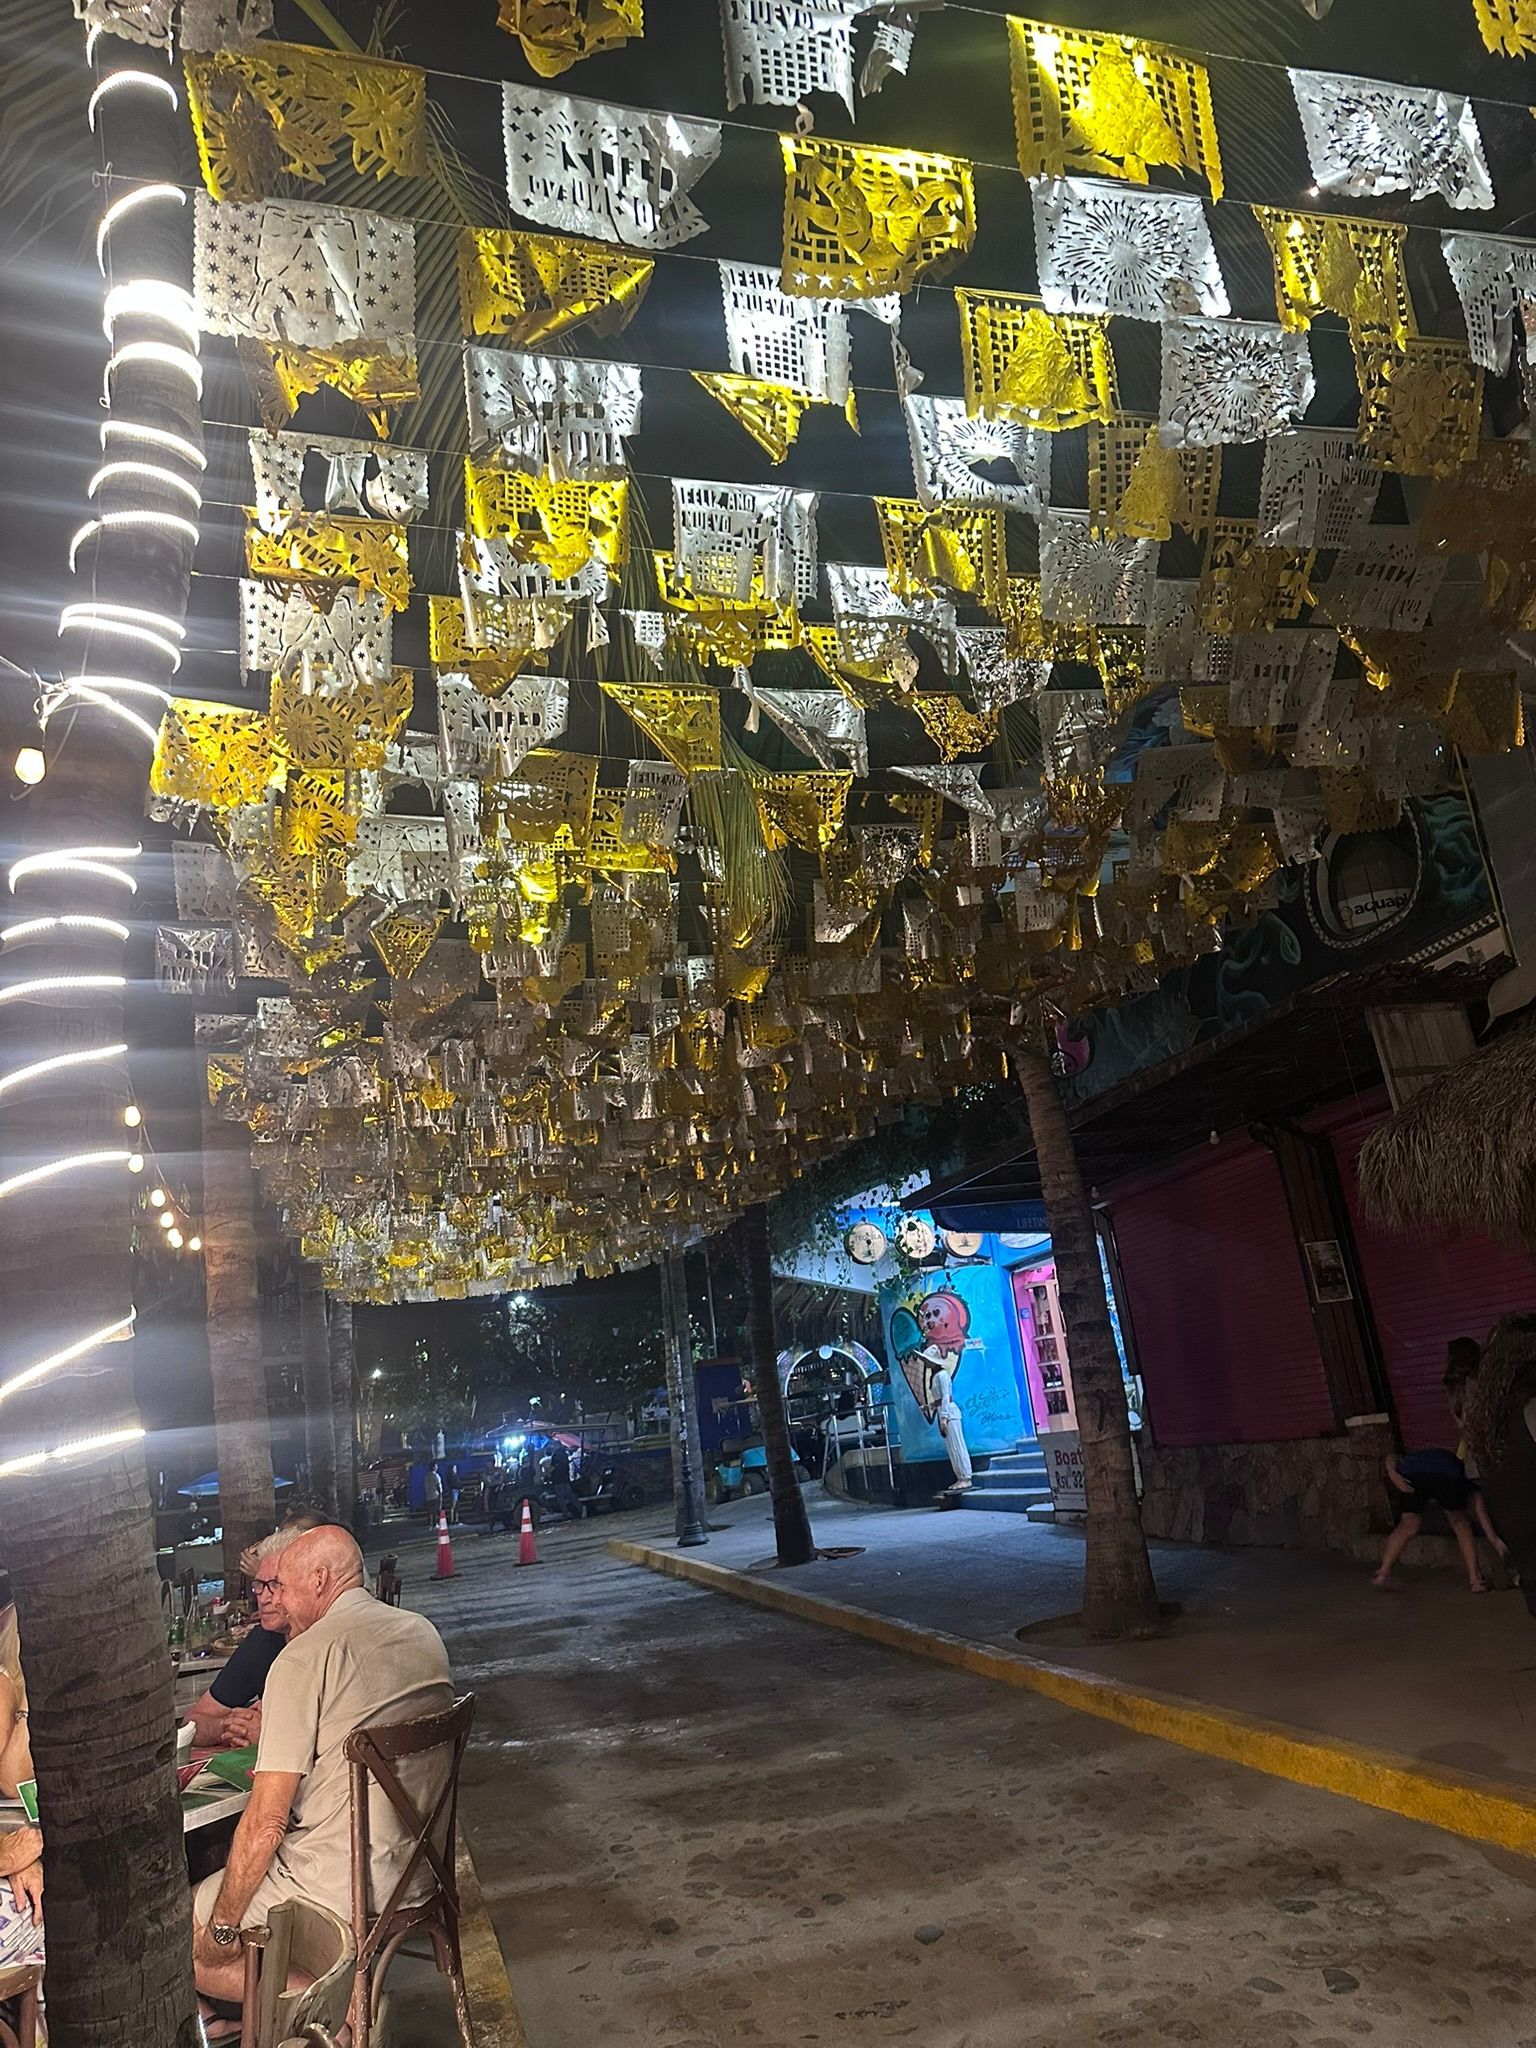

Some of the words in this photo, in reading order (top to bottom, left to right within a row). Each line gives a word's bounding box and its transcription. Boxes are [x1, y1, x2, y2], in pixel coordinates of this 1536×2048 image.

[682, 488, 721, 511] FELIZ
[683, 511, 731, 533] NUEVO
[1016, 1215, 1048, 1229] LIFETIM
